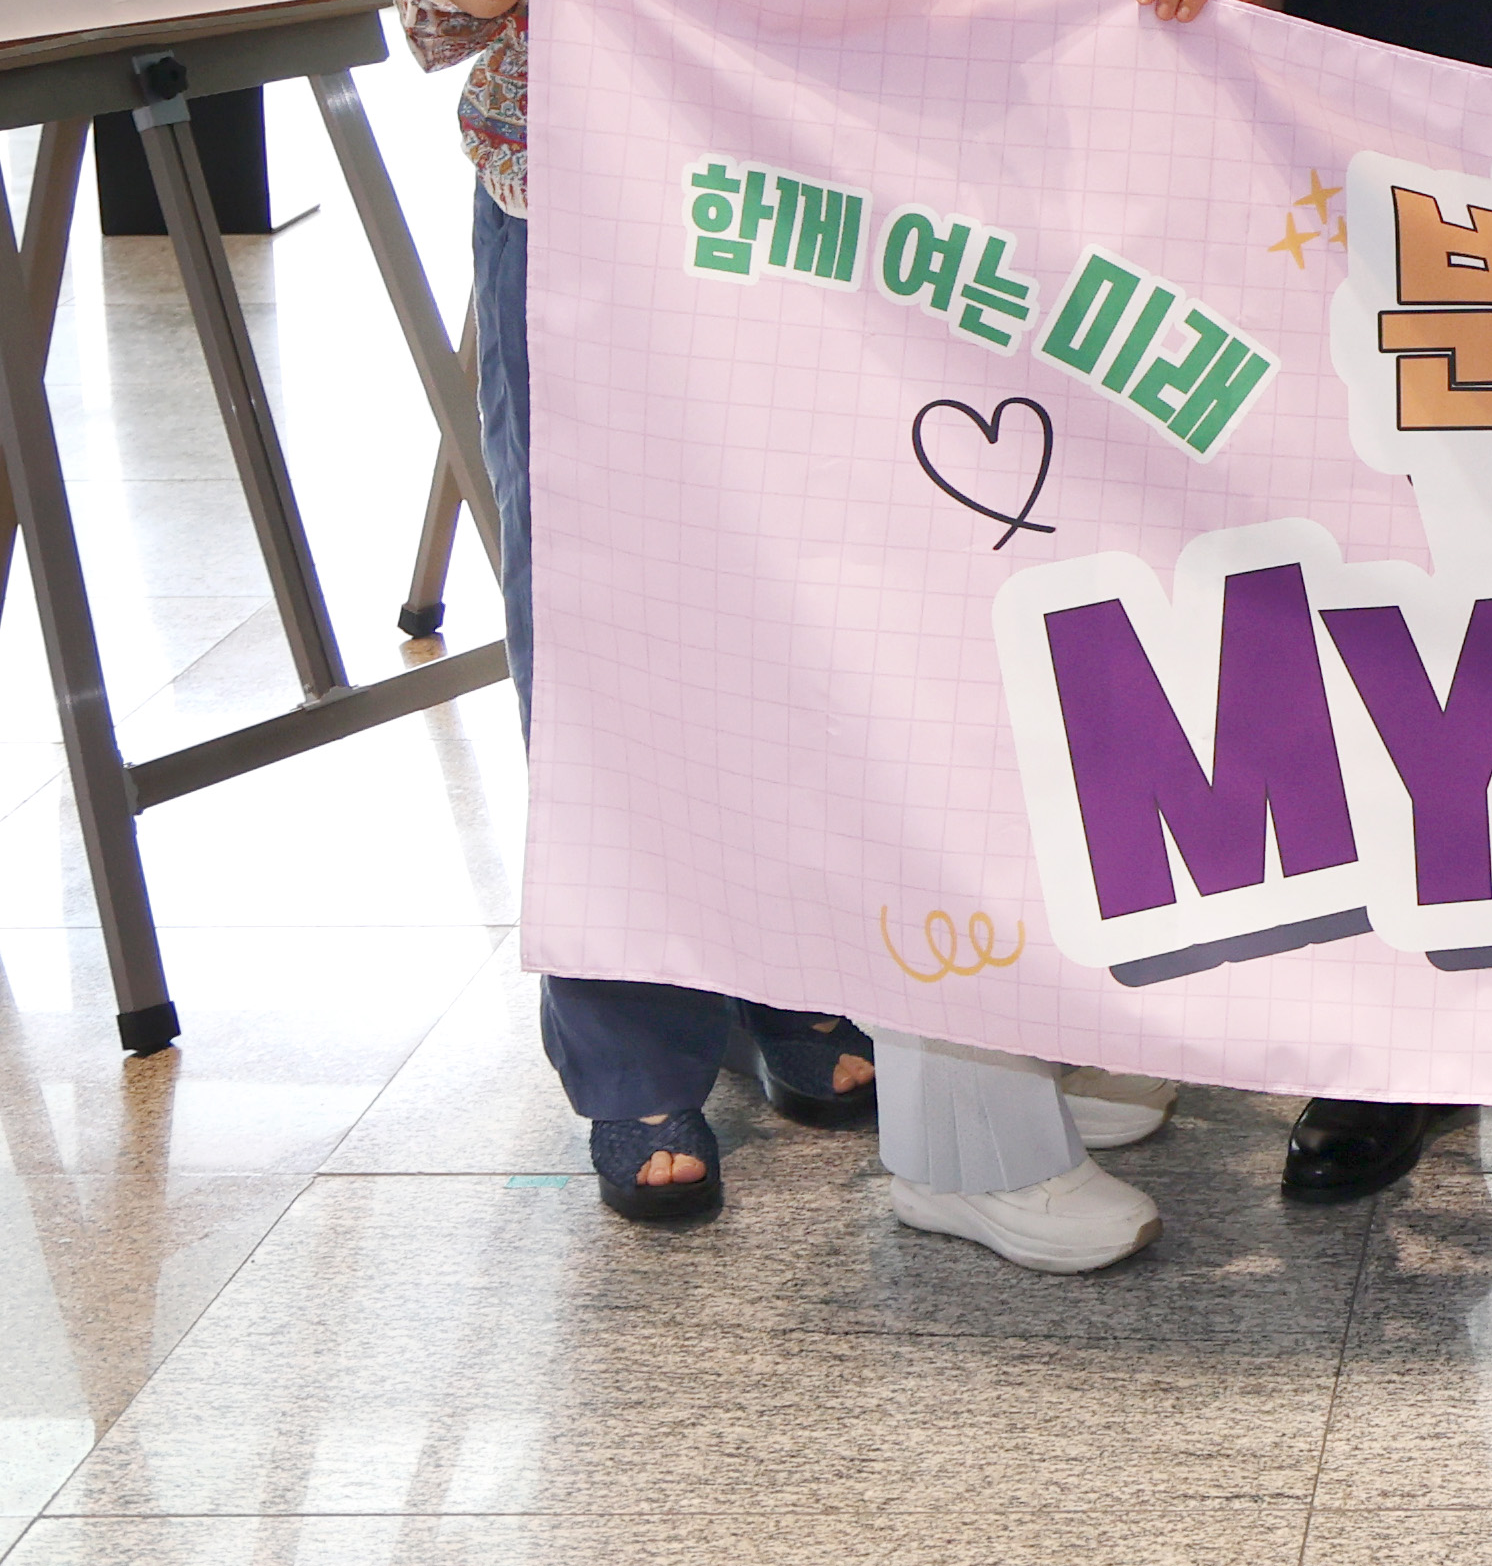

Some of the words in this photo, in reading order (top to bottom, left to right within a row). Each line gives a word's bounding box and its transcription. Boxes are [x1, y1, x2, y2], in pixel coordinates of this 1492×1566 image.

[690, 162, 864, 283] 함께
[881, 211, 1031, 348] 여는
[1041, 252, 1272, 455] 미래
